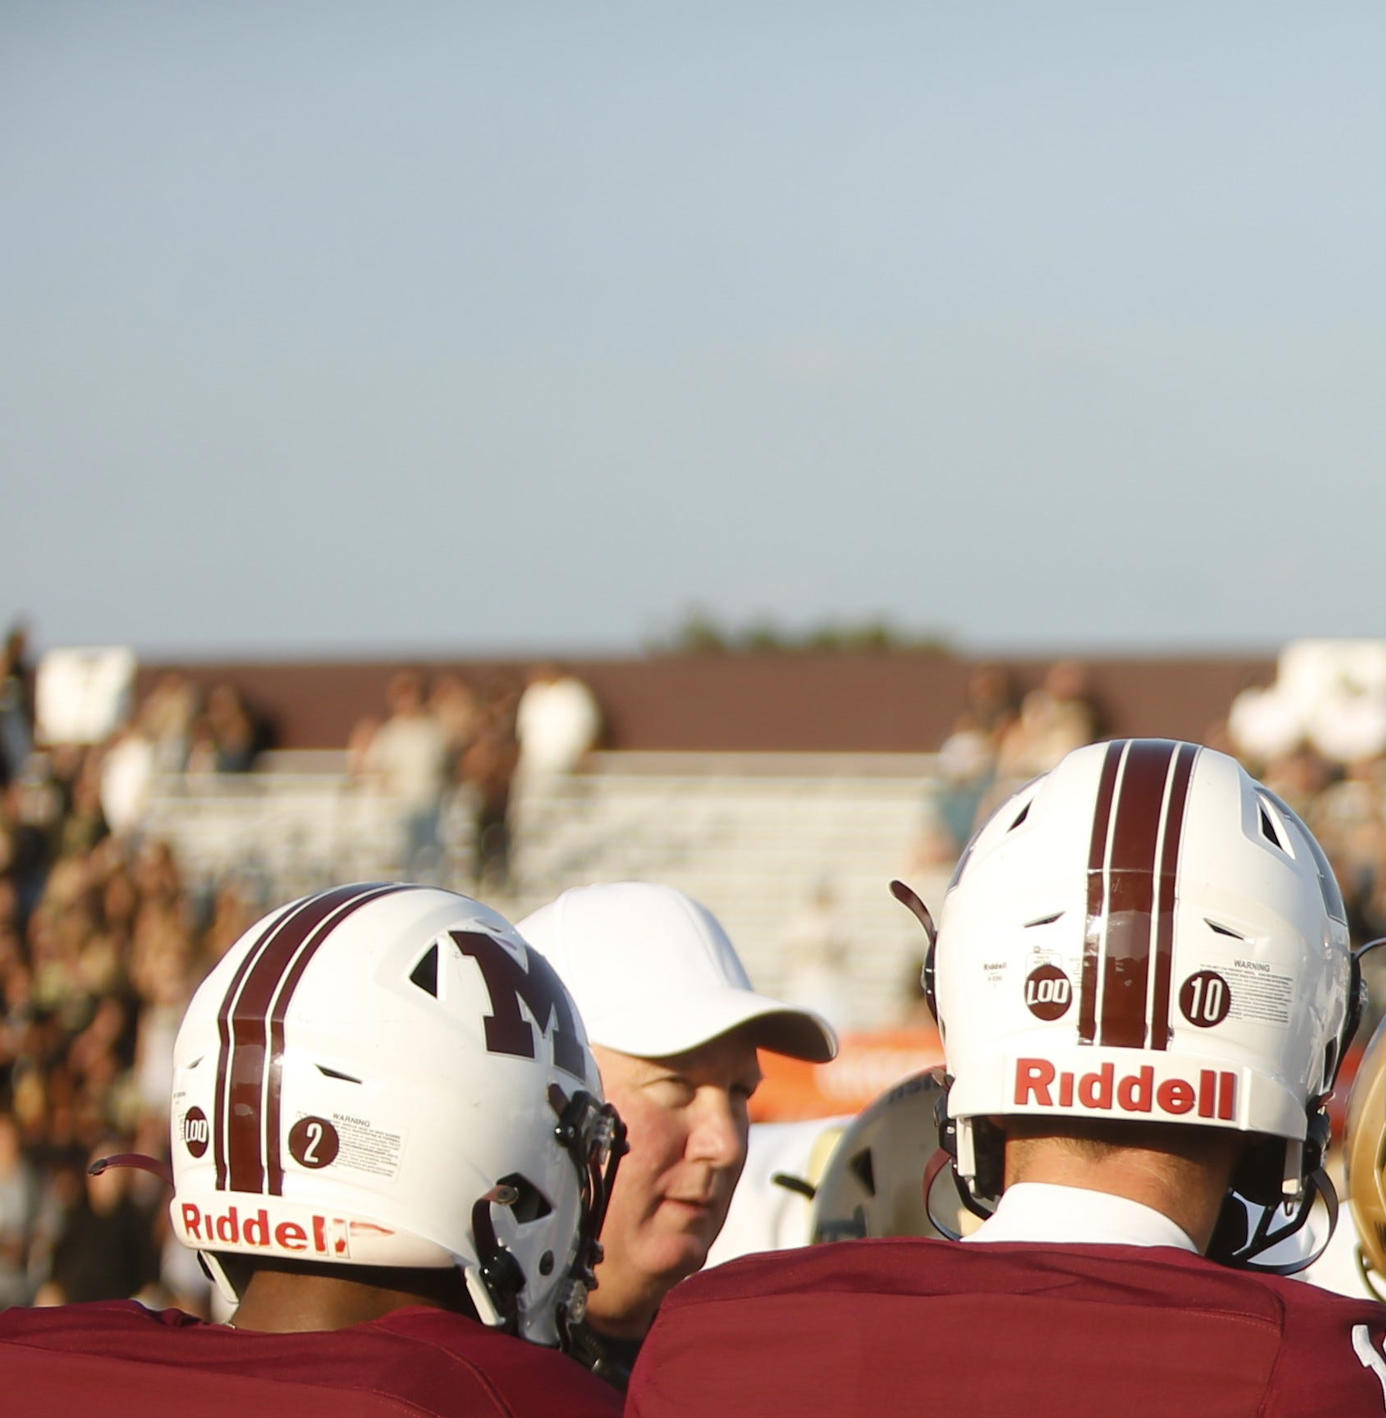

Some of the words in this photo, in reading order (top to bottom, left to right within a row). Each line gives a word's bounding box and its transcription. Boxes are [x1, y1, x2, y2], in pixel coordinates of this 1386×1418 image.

[1234, 960, 1270, 972] WARNING
[1026, 979, 1070, 1006] LOD
[1191, 977, 1223, 1022] 10
[1013, 1057, 1237, 1121] Riddell
[185, 1119, 208, 1143] LOD
[333, 1113, 370, 1128] WARNING
[303, 1123, 323, 1163] 2
